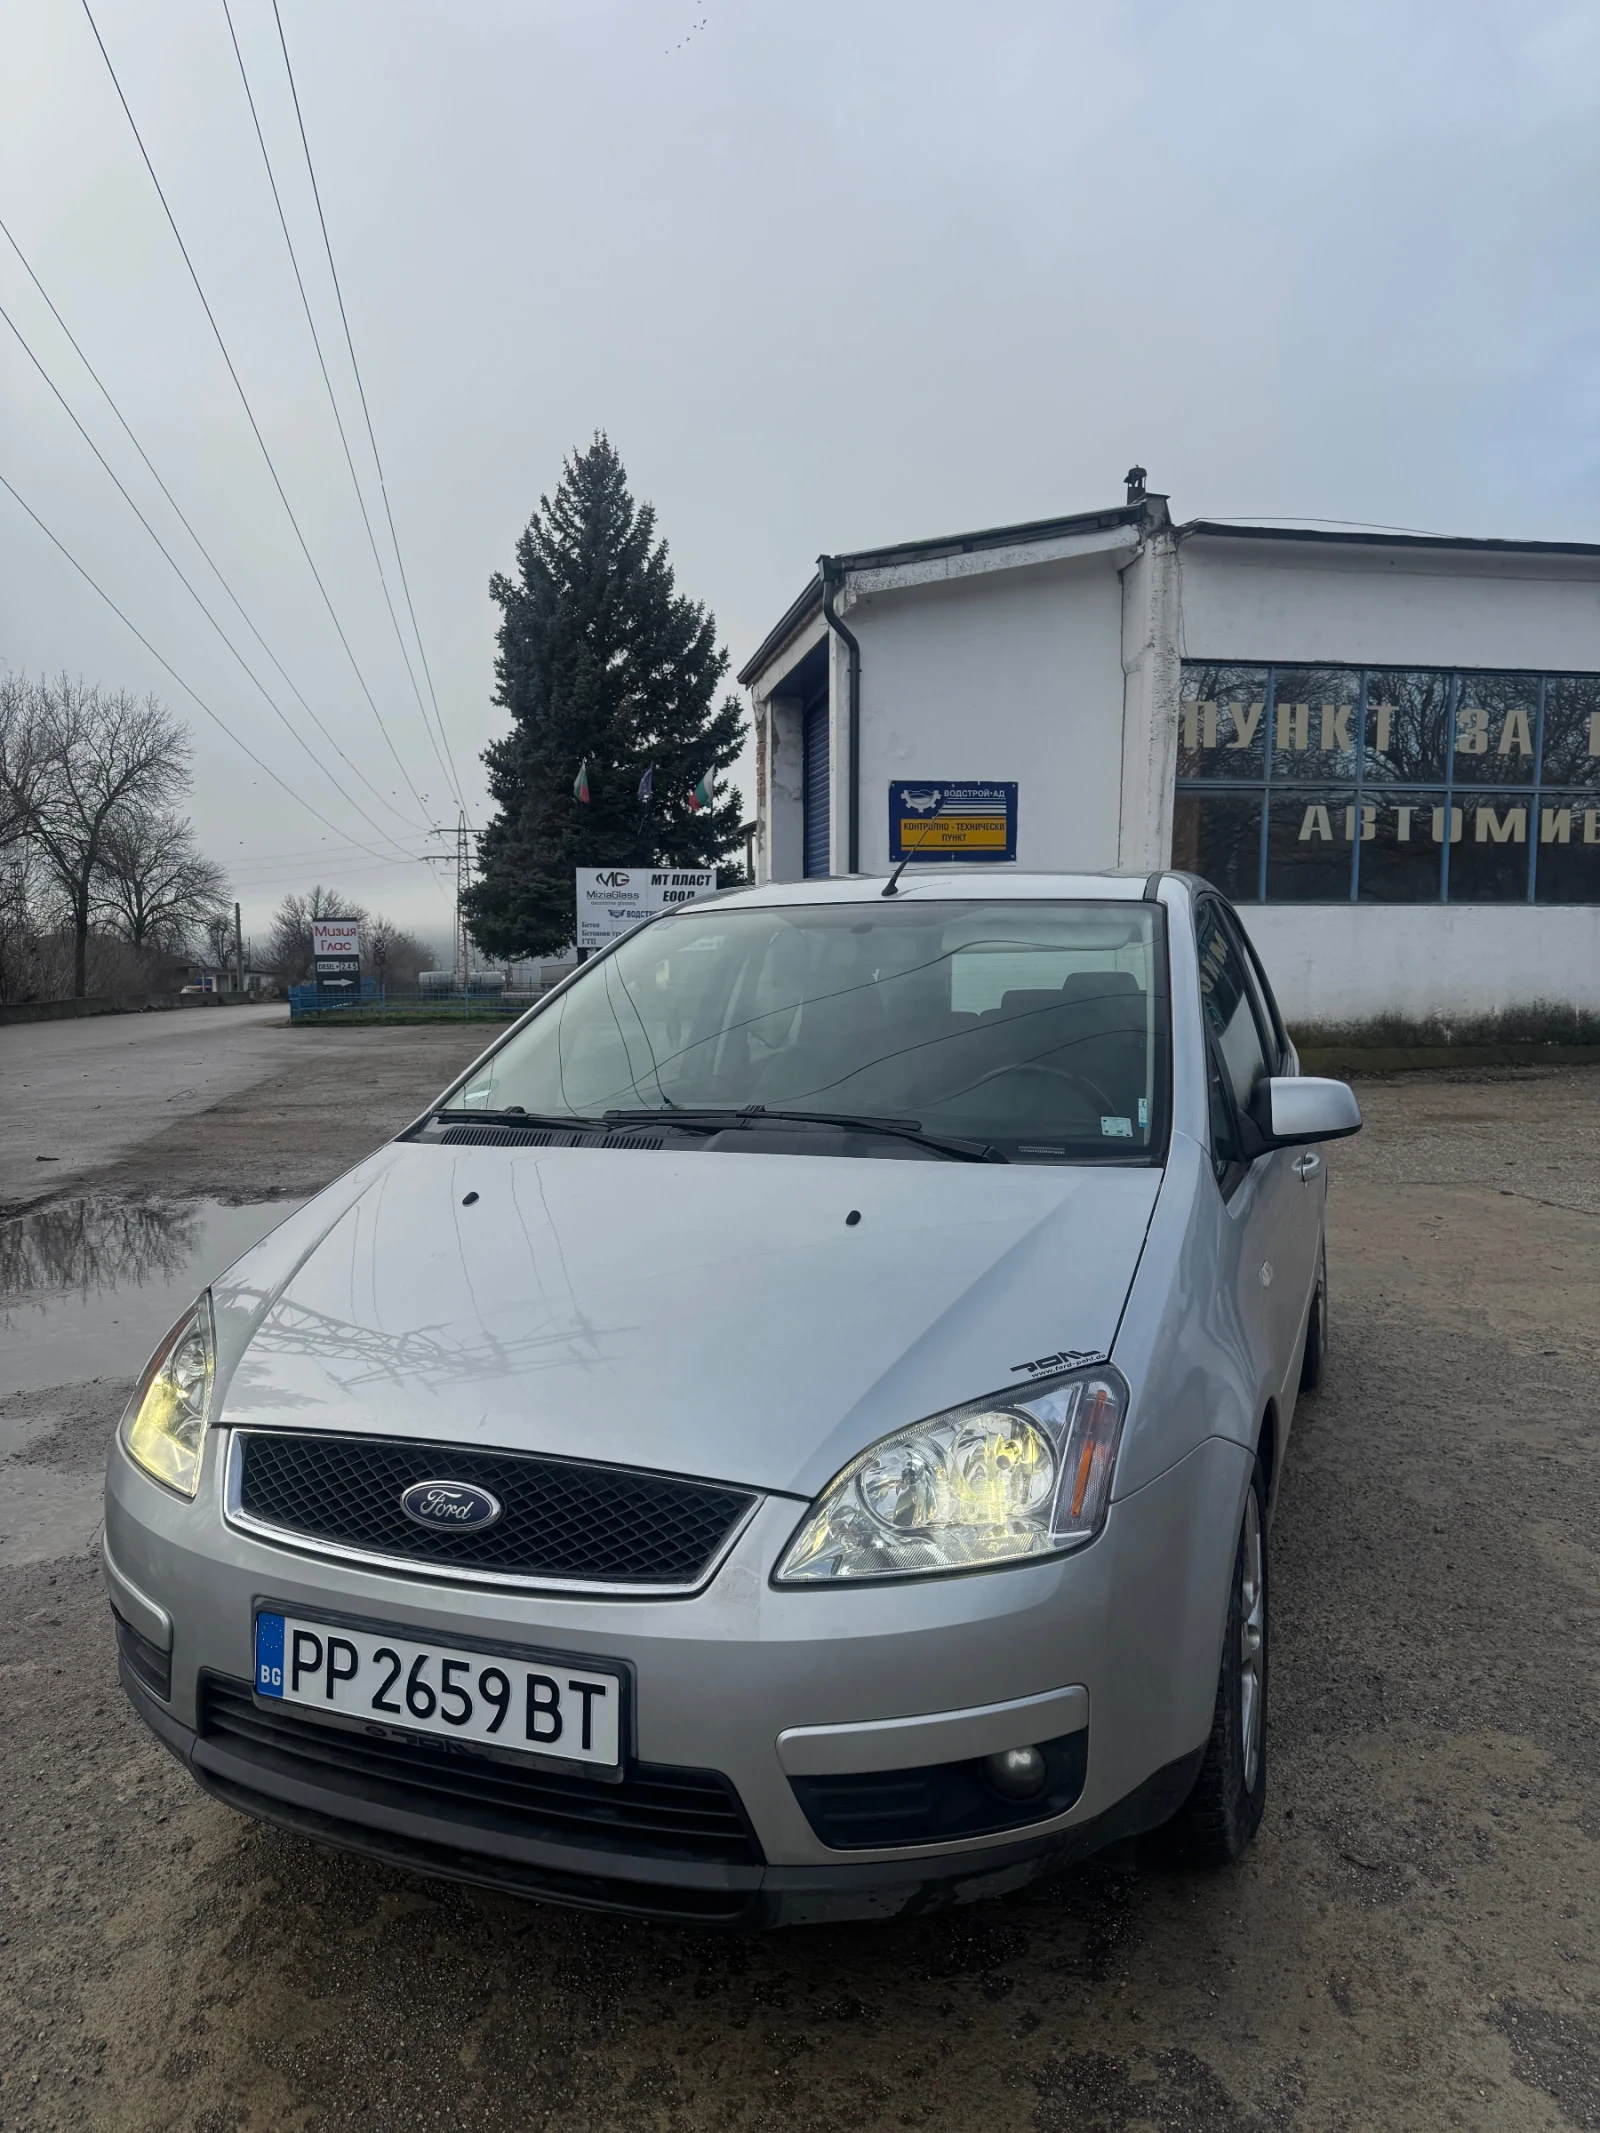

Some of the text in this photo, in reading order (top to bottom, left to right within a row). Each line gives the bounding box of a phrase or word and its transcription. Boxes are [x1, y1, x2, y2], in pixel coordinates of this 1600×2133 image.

[1184, 701, 1399, 752] ПУНКТ
[1456, 708, 1533, 755] ЗА
[956, 822, 1005, 831] ТЕХНИЧЕСКИ
[942, 833, 967, 842] ПУНКТ
[596, 872, 630, 887] MG
[651, 874, 712, 887] МТ ПЛАСТ
[586, 891, 640, 900] MiziaGlass
[315, 926, 356, 937] Мизия
[321, 940, 352, 951] Глас
[420, 1489, 474, 1520] Ford
[260, 1664, 282, 1686] BG
[292, 1629, 606, 1750] PP 2659 BT
